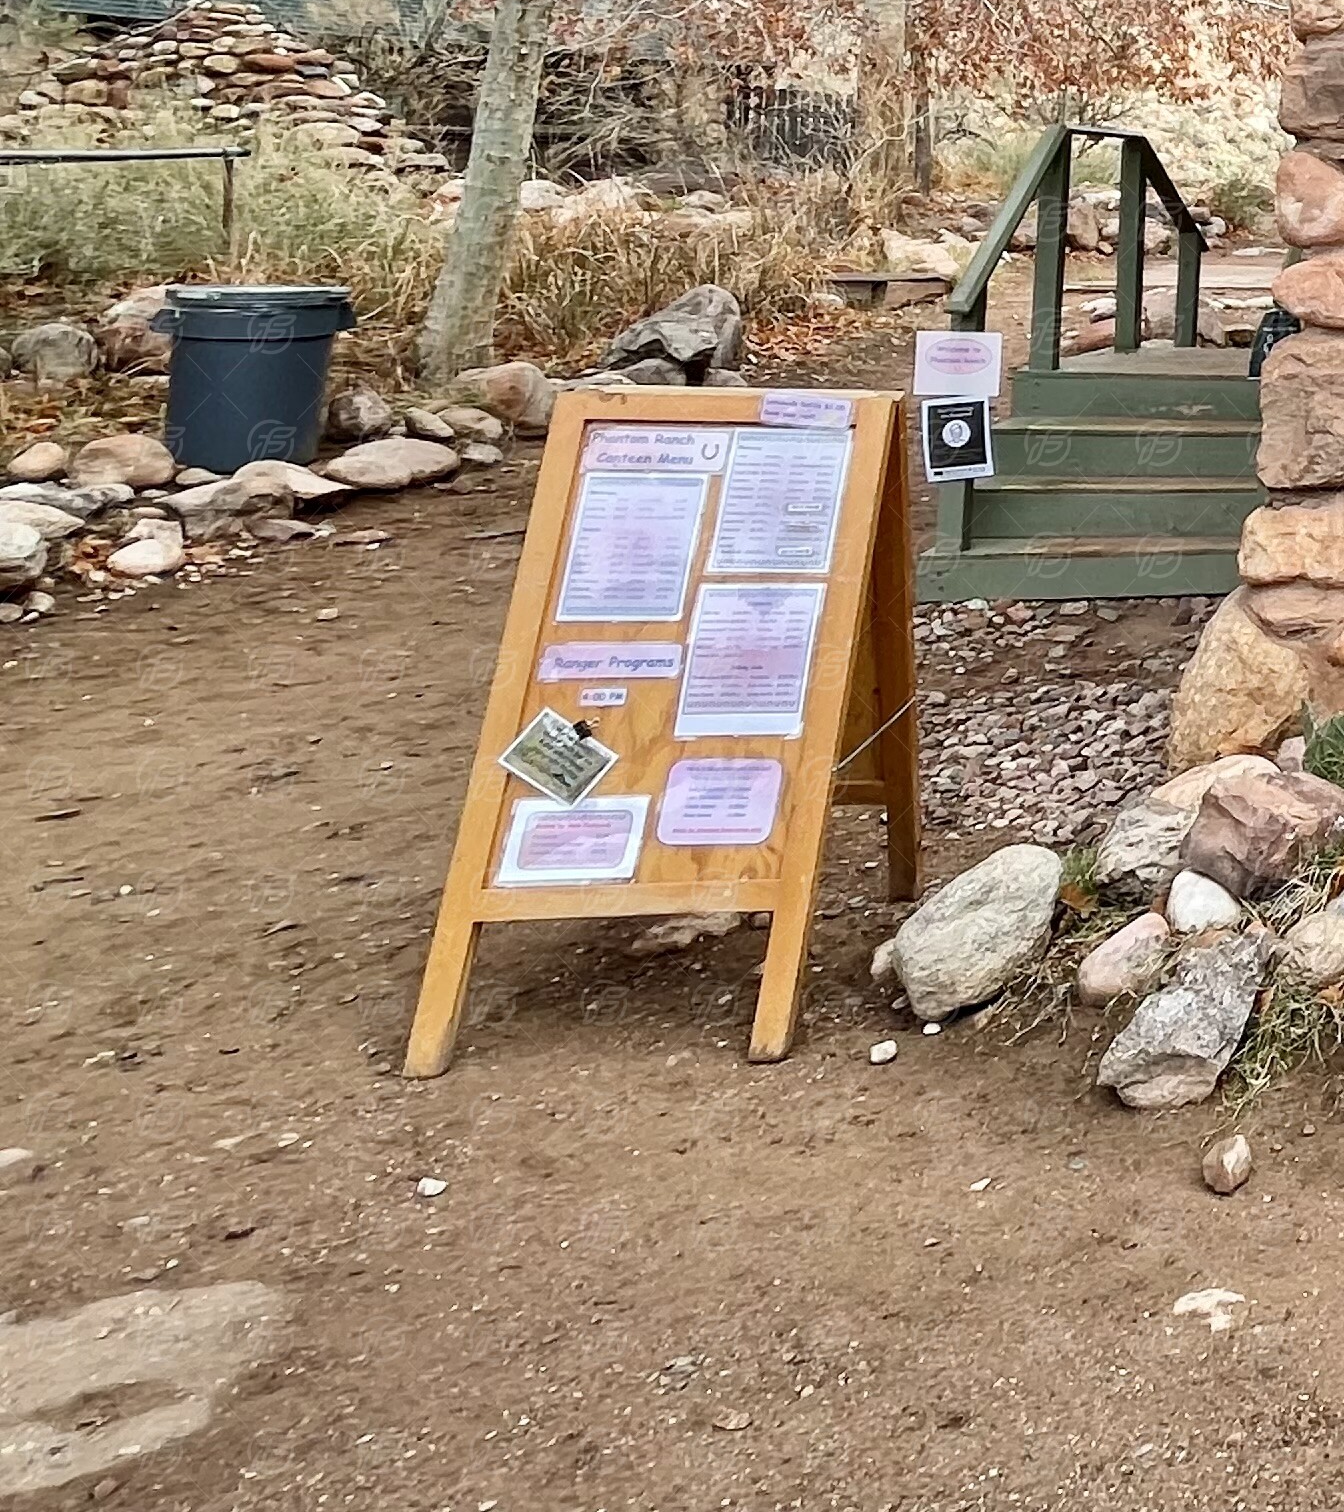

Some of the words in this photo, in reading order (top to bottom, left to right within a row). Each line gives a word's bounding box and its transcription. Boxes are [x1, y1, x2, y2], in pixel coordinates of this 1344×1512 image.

[592, 432, 650, 444] Phantom
[653, 433, 696, 445] Ranch
[596, 452, 652, 464] Canteen
[656, 453, 694, 466] Menu
[553, 656, 604, 672] Ranger
[608, 655, 675, 672] Programs
[609, 692, 624, 701] PM
